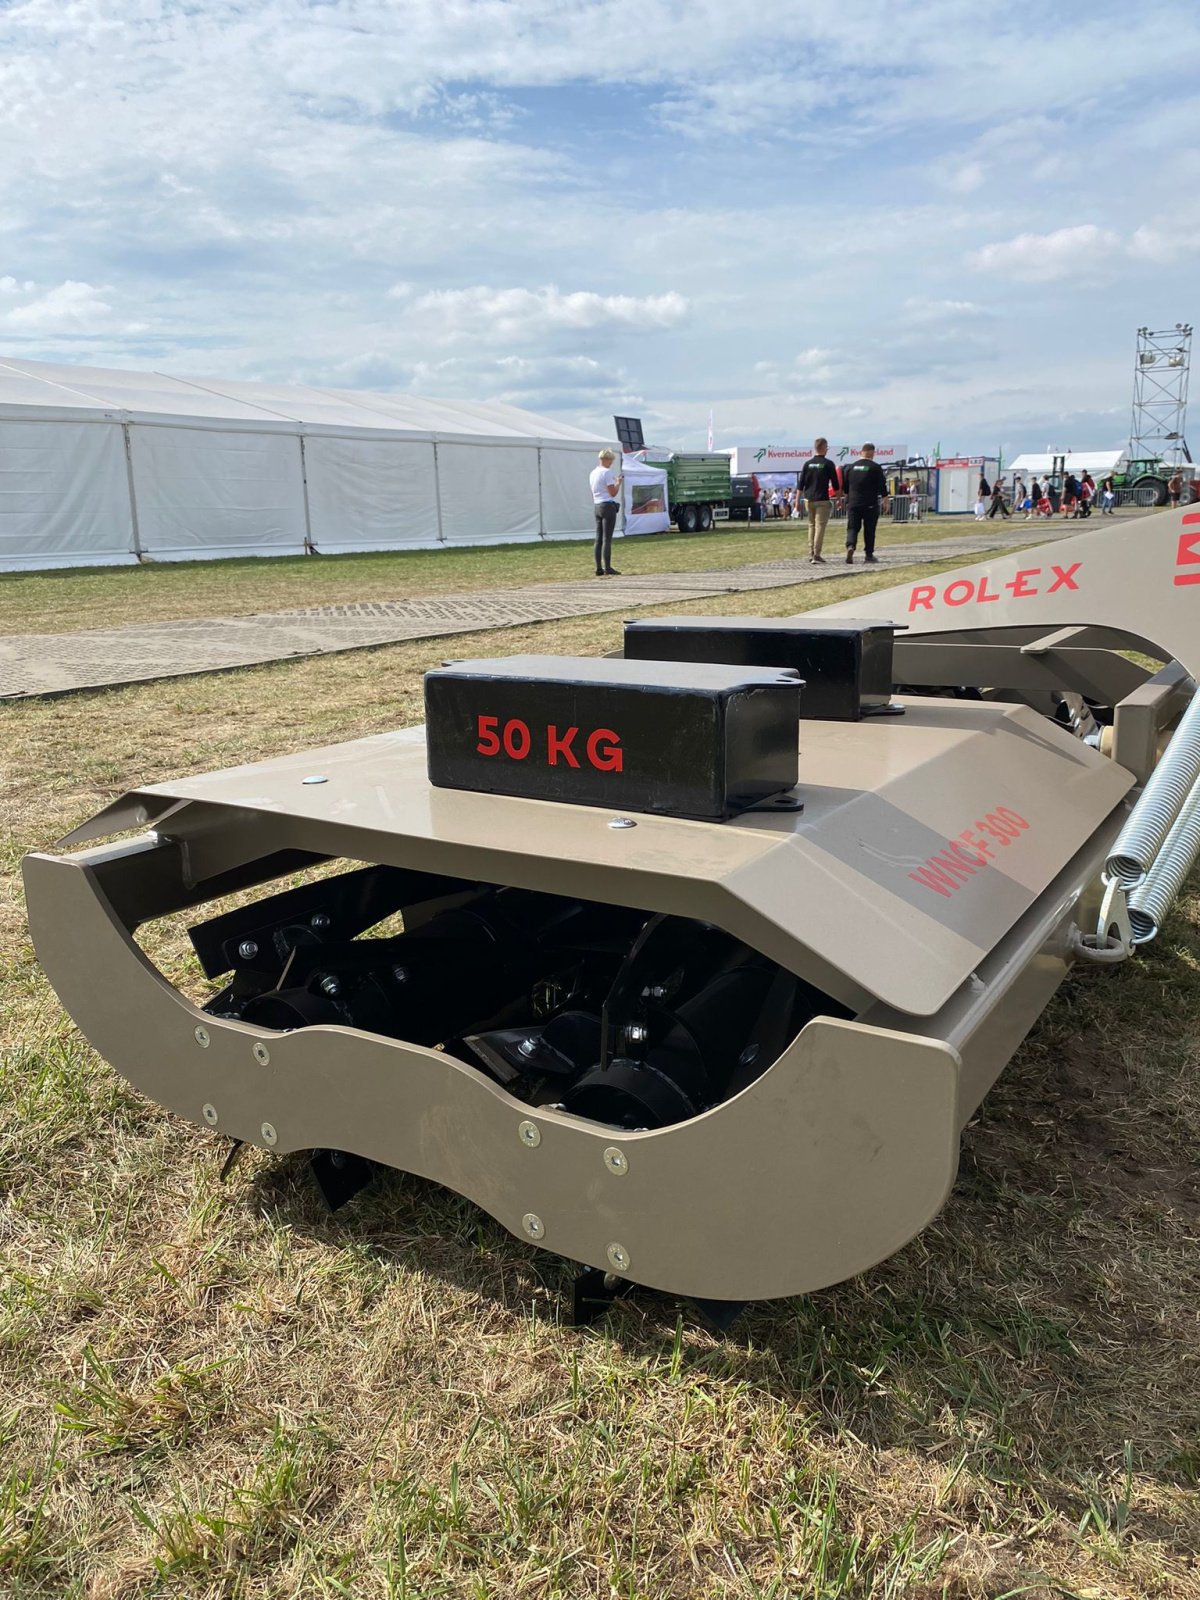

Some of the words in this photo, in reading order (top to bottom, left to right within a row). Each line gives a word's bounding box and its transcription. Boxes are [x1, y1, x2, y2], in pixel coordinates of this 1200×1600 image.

[768, 450, 812, 458] Kverneland
[908, 562, 1082, 613] ROLEX
[476, 715, 531, 760] 50
[547, 724, 624, 772] KG
[975, 806, 1030, 846] 300
